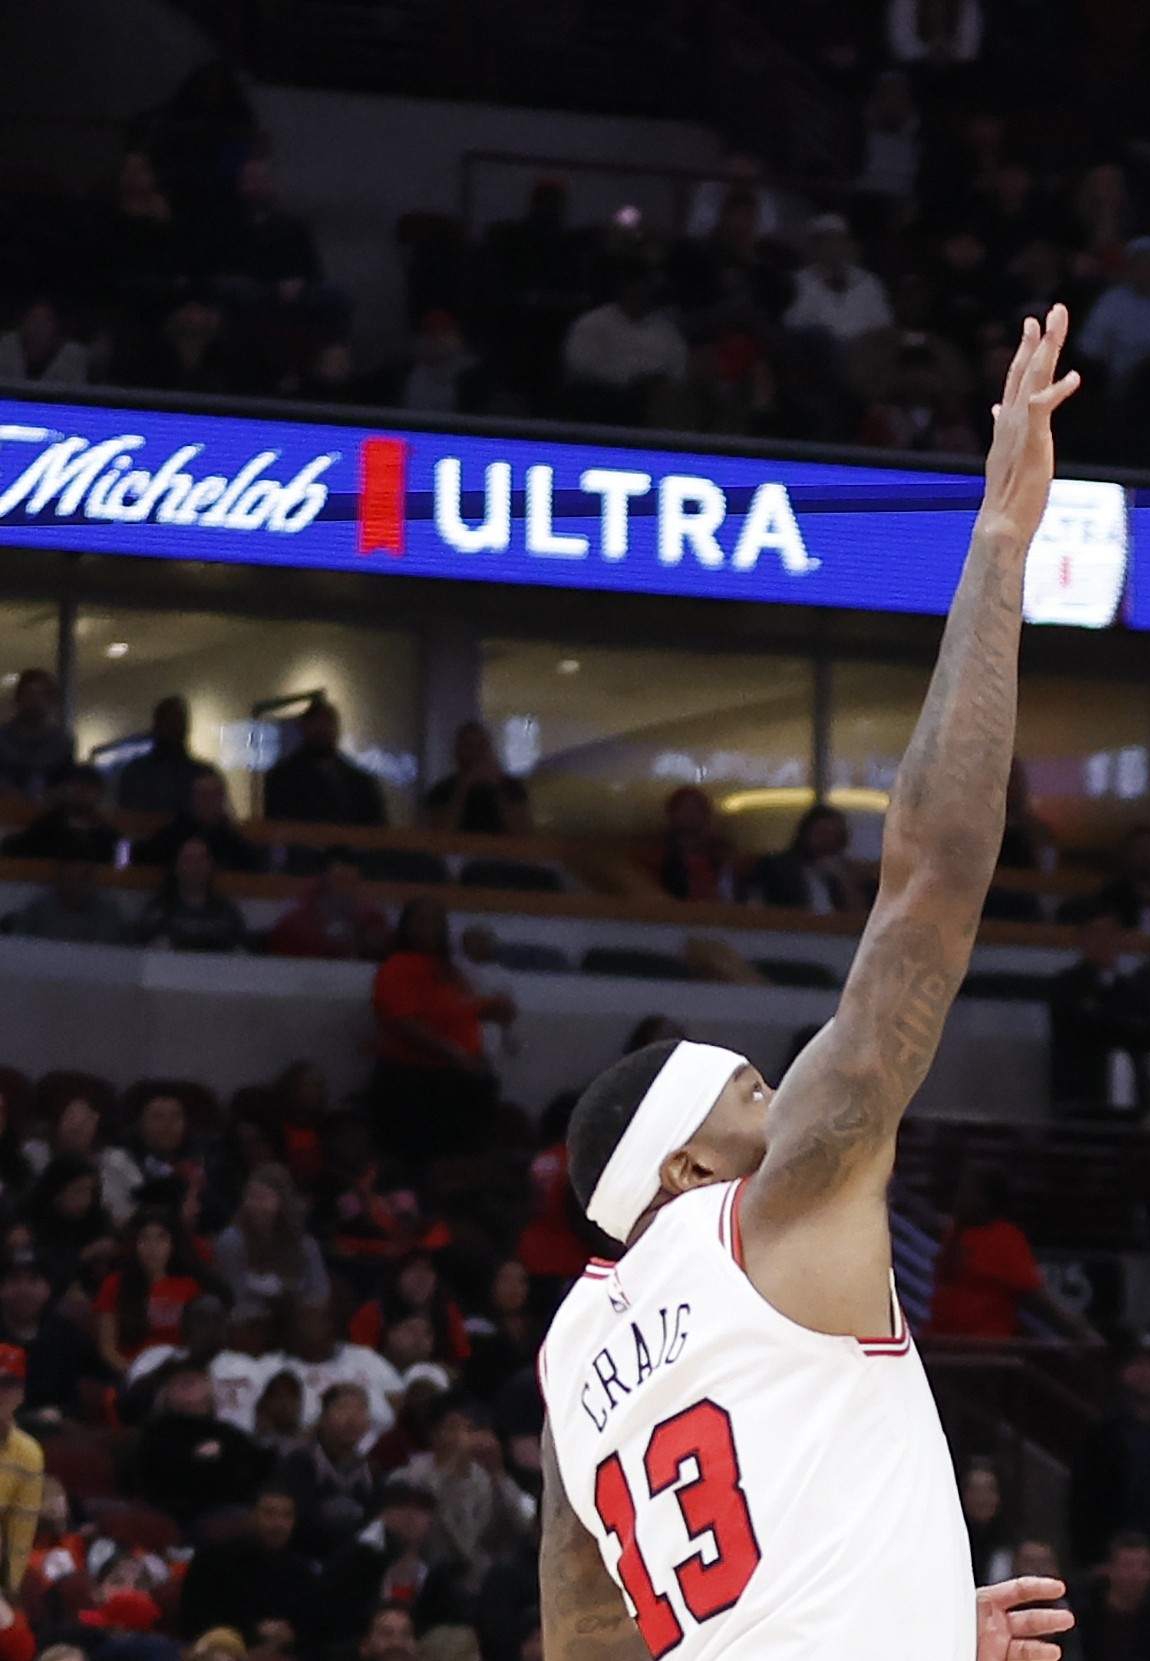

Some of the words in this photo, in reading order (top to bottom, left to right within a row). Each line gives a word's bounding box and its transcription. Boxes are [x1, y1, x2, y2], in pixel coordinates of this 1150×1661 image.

[0, 424, 342, 533] Michelob
[434, 457, 812, 575] ULTRA
[581, 1302, 691, 1433] CRAIG
[594, 1397, 762, 1661] 13
